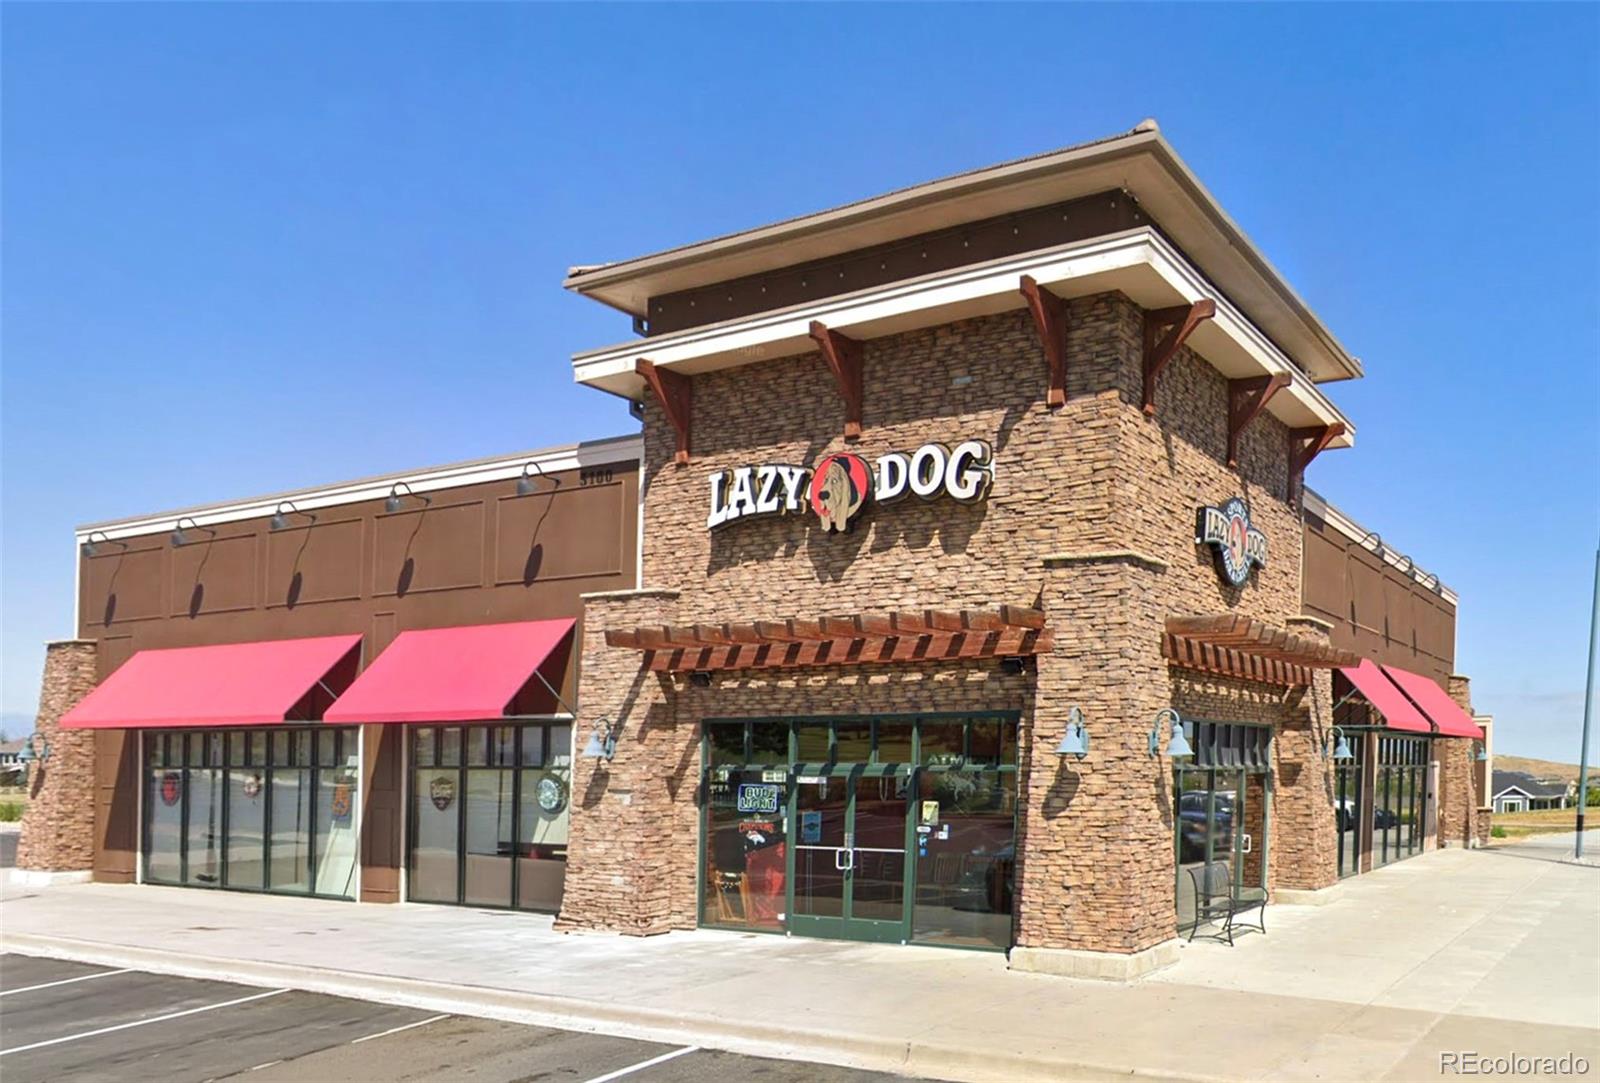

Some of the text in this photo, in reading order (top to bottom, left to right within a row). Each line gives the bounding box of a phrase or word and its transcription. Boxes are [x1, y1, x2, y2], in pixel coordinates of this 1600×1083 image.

[706, 440, 992, 530] LAZY DOG
[1207, 511, 1265, 562] LAZY DOG
[740, 797, 773, 809] LIGHT
[744, 787, 770, 799] BUD
